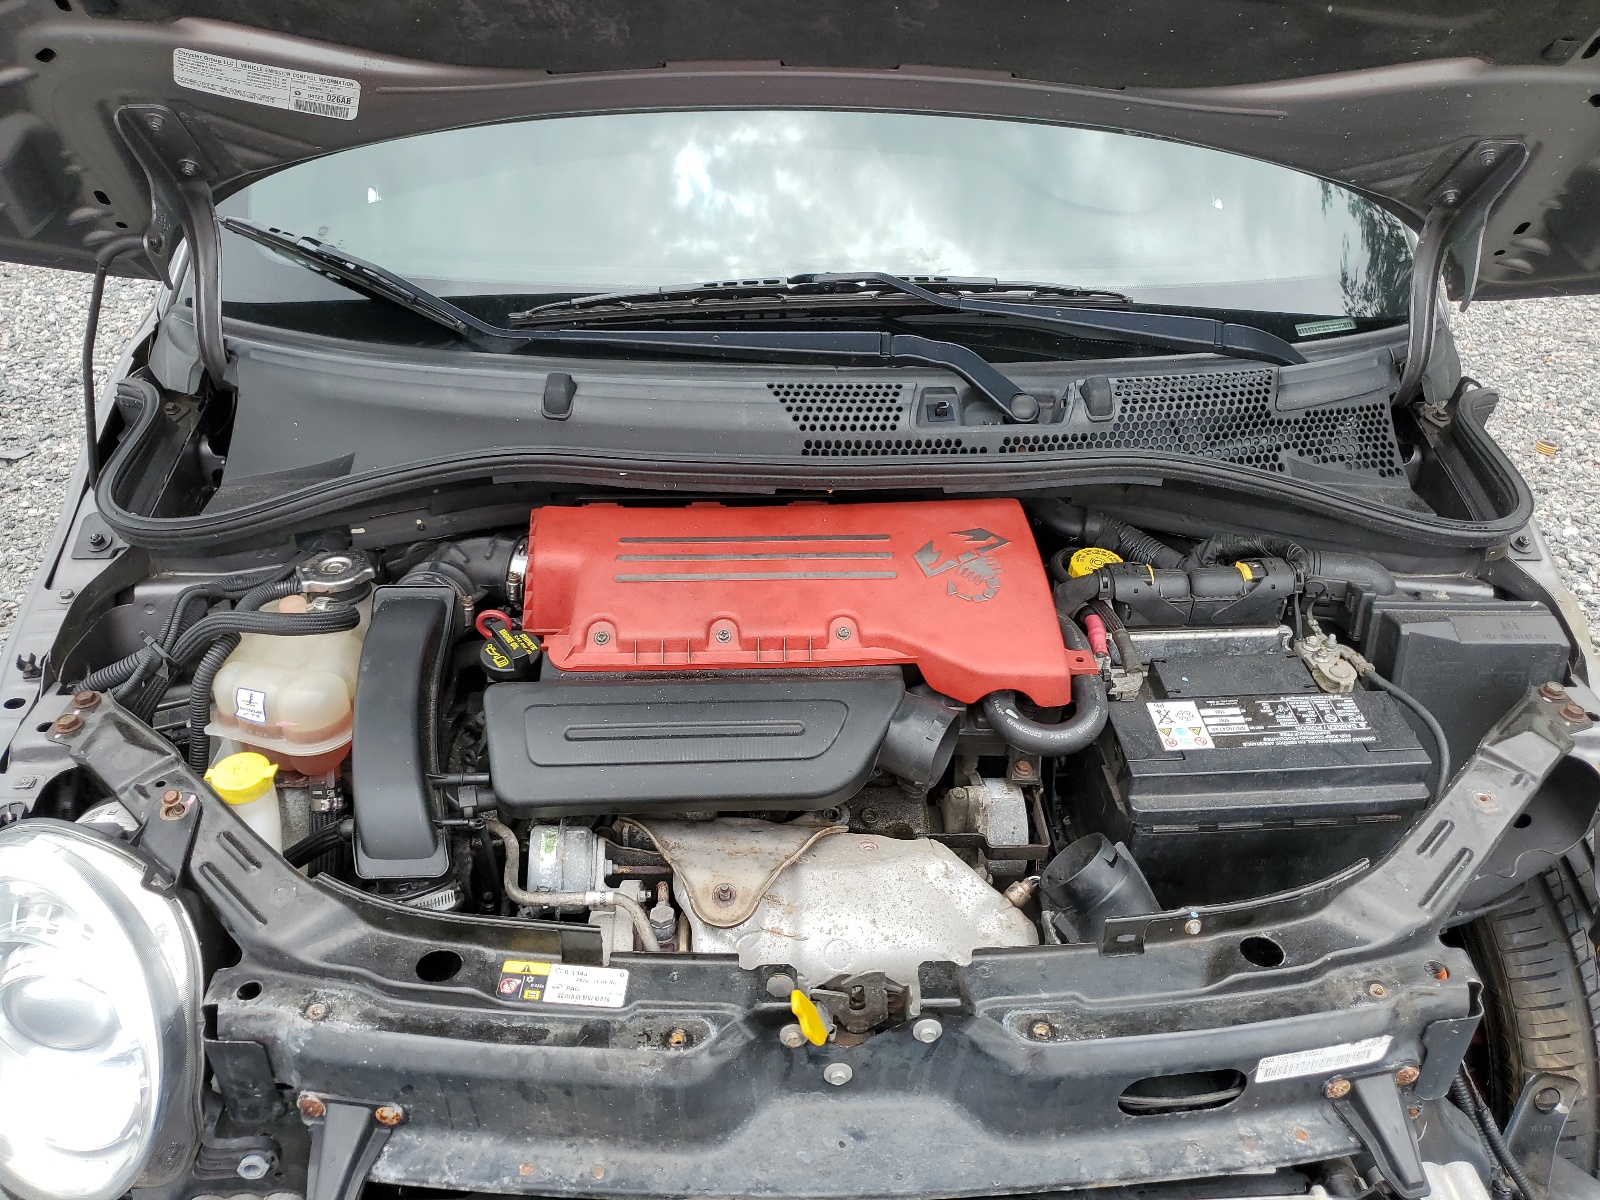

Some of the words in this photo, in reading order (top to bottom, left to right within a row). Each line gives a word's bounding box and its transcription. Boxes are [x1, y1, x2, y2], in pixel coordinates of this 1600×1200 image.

[178, 49, 202, 60] Chrysler
[203, 55, 222, 64] Group
[240, 63, 263, 72] VEHICLE
[292, 72, 317, 82] CONTROL
[318, 77, 354, 88] INFORMATION
[326, 94, 352, 105] 026AB
